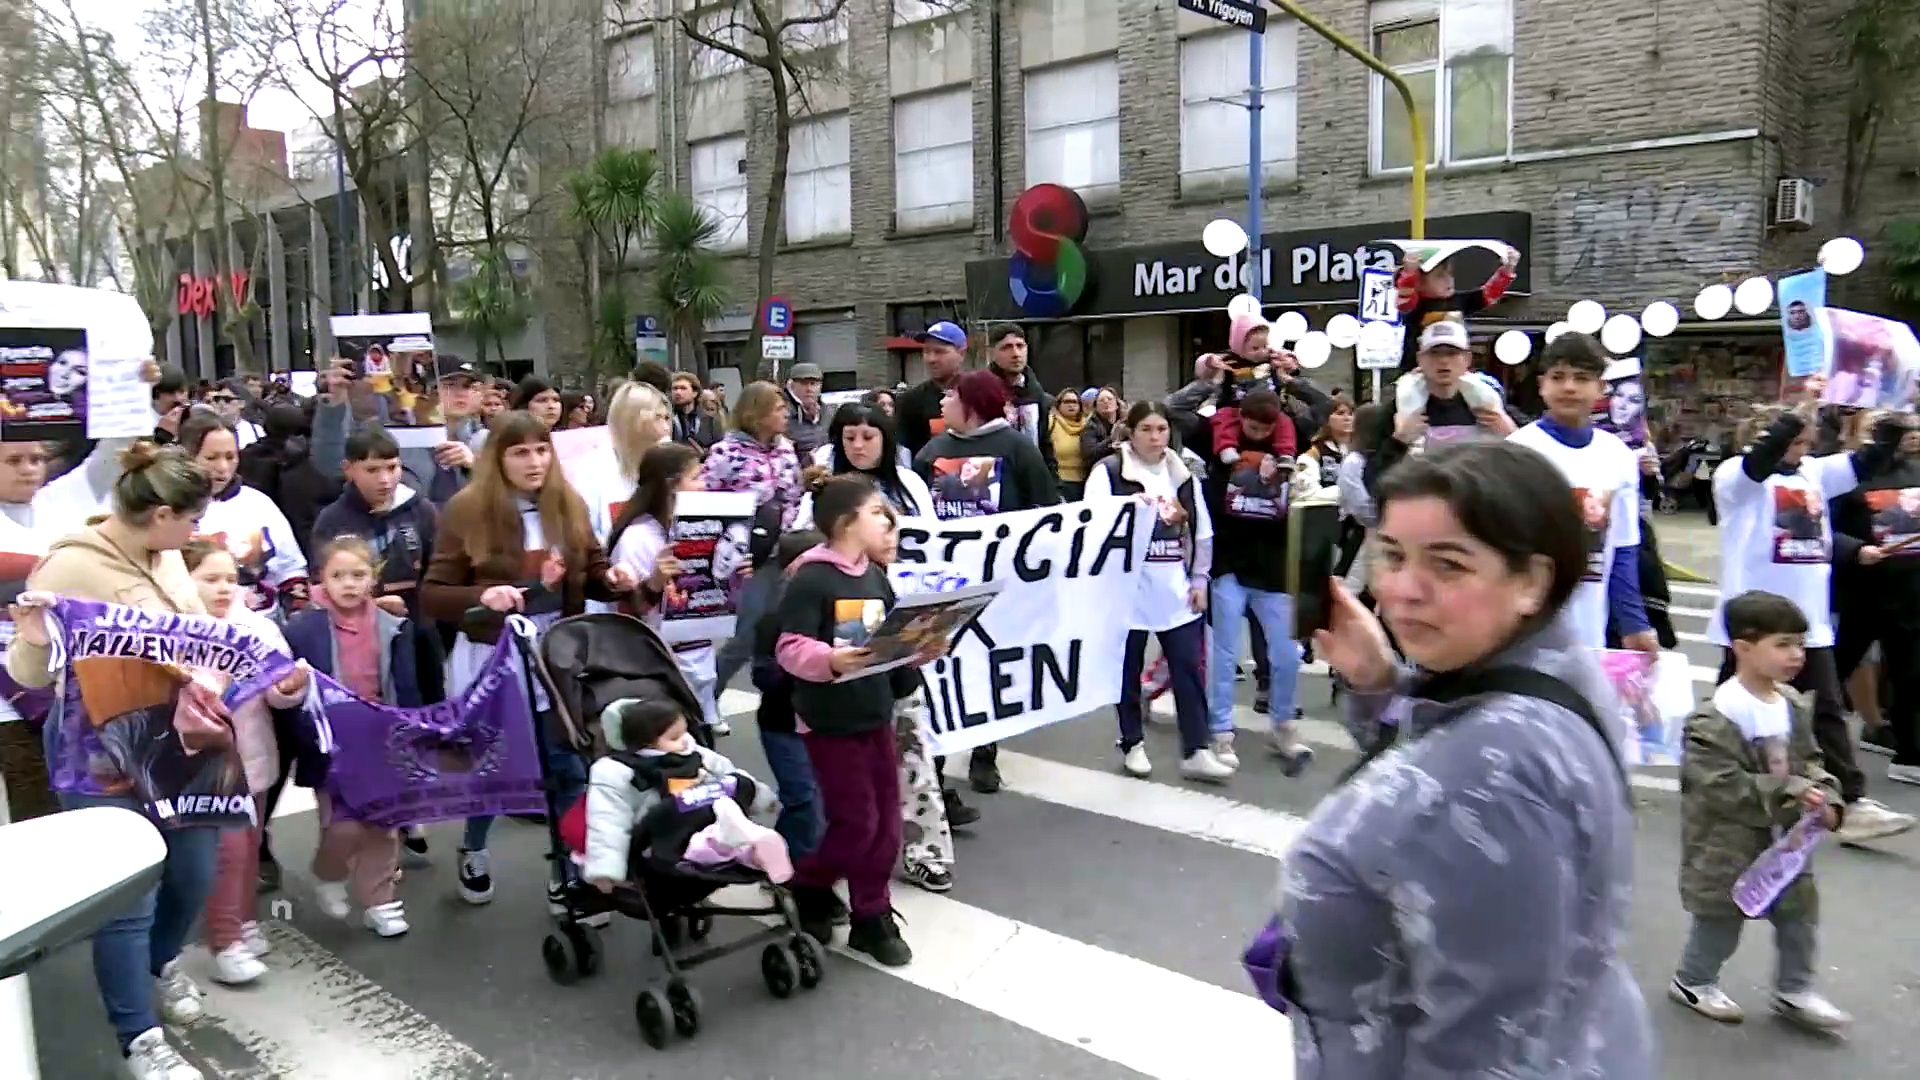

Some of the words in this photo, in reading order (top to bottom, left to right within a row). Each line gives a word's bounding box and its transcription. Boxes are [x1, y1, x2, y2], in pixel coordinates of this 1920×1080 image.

[1207, 0, 1254, 25] Yrigoyen
[1134, 260, 1203, 296] Mar
[1292, 243, 1396, 285] Plata
[178, 271, 249, 318] Dex
[770, 307, 786, 328] E
[895, 502, 1137, 583] STiCiA
[71, 630, 176, 665] MAILEN
[920, 638, 1083, 735] iLEN
[176, 793, 258, 825] MENO
